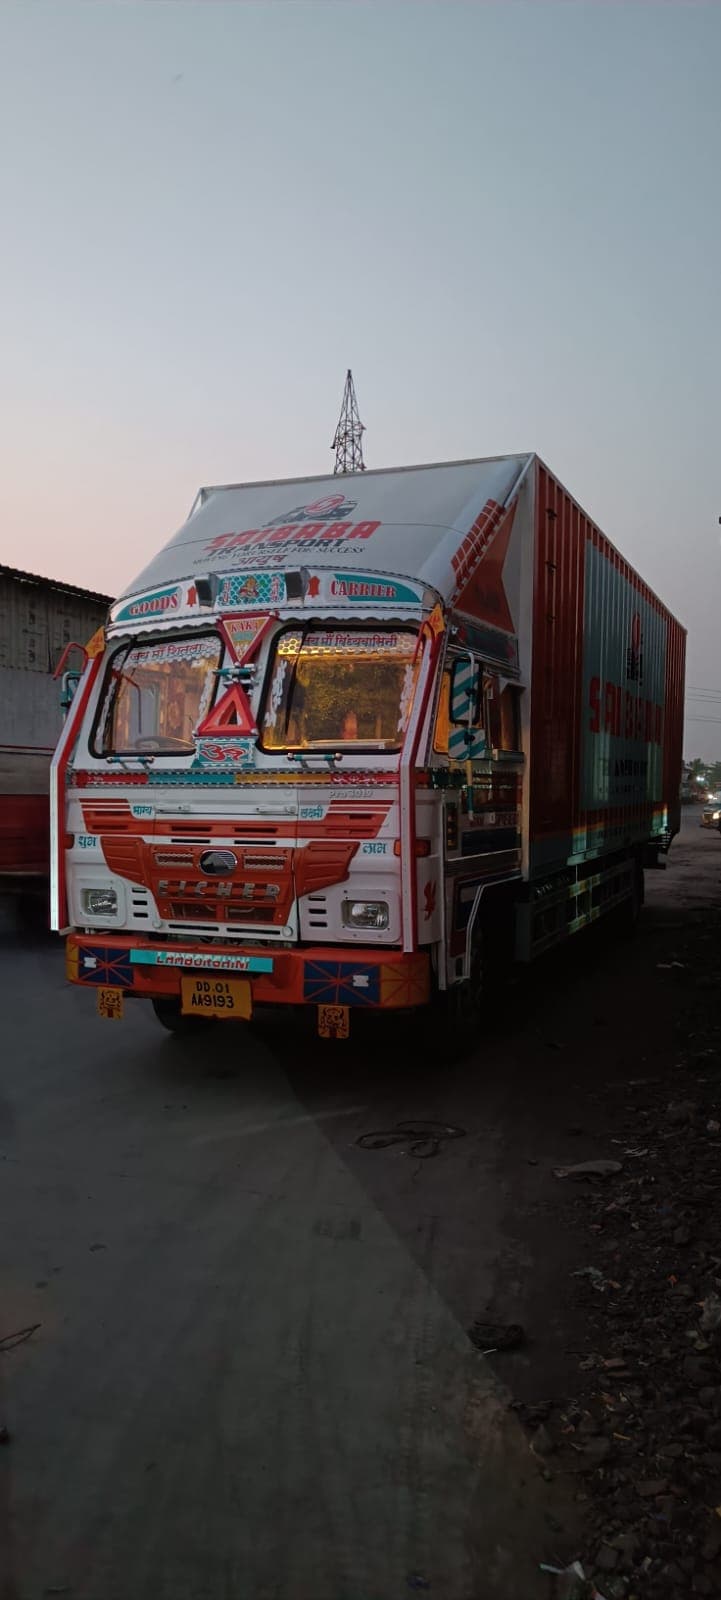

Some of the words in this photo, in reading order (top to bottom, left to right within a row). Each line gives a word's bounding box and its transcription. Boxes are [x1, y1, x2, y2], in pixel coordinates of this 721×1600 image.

[203, 521, 381, 550] SAIBABA
[208, 539, 350, 556] TRANSPORT
[330, 580, 395, 598] CARRIER
[130, 593, 178, 615] GOODS
[362, 842, 388, 855] लाभ
[158, 880, 280, 900] EICHER
[191, 994, 235, 1009] AA9193
